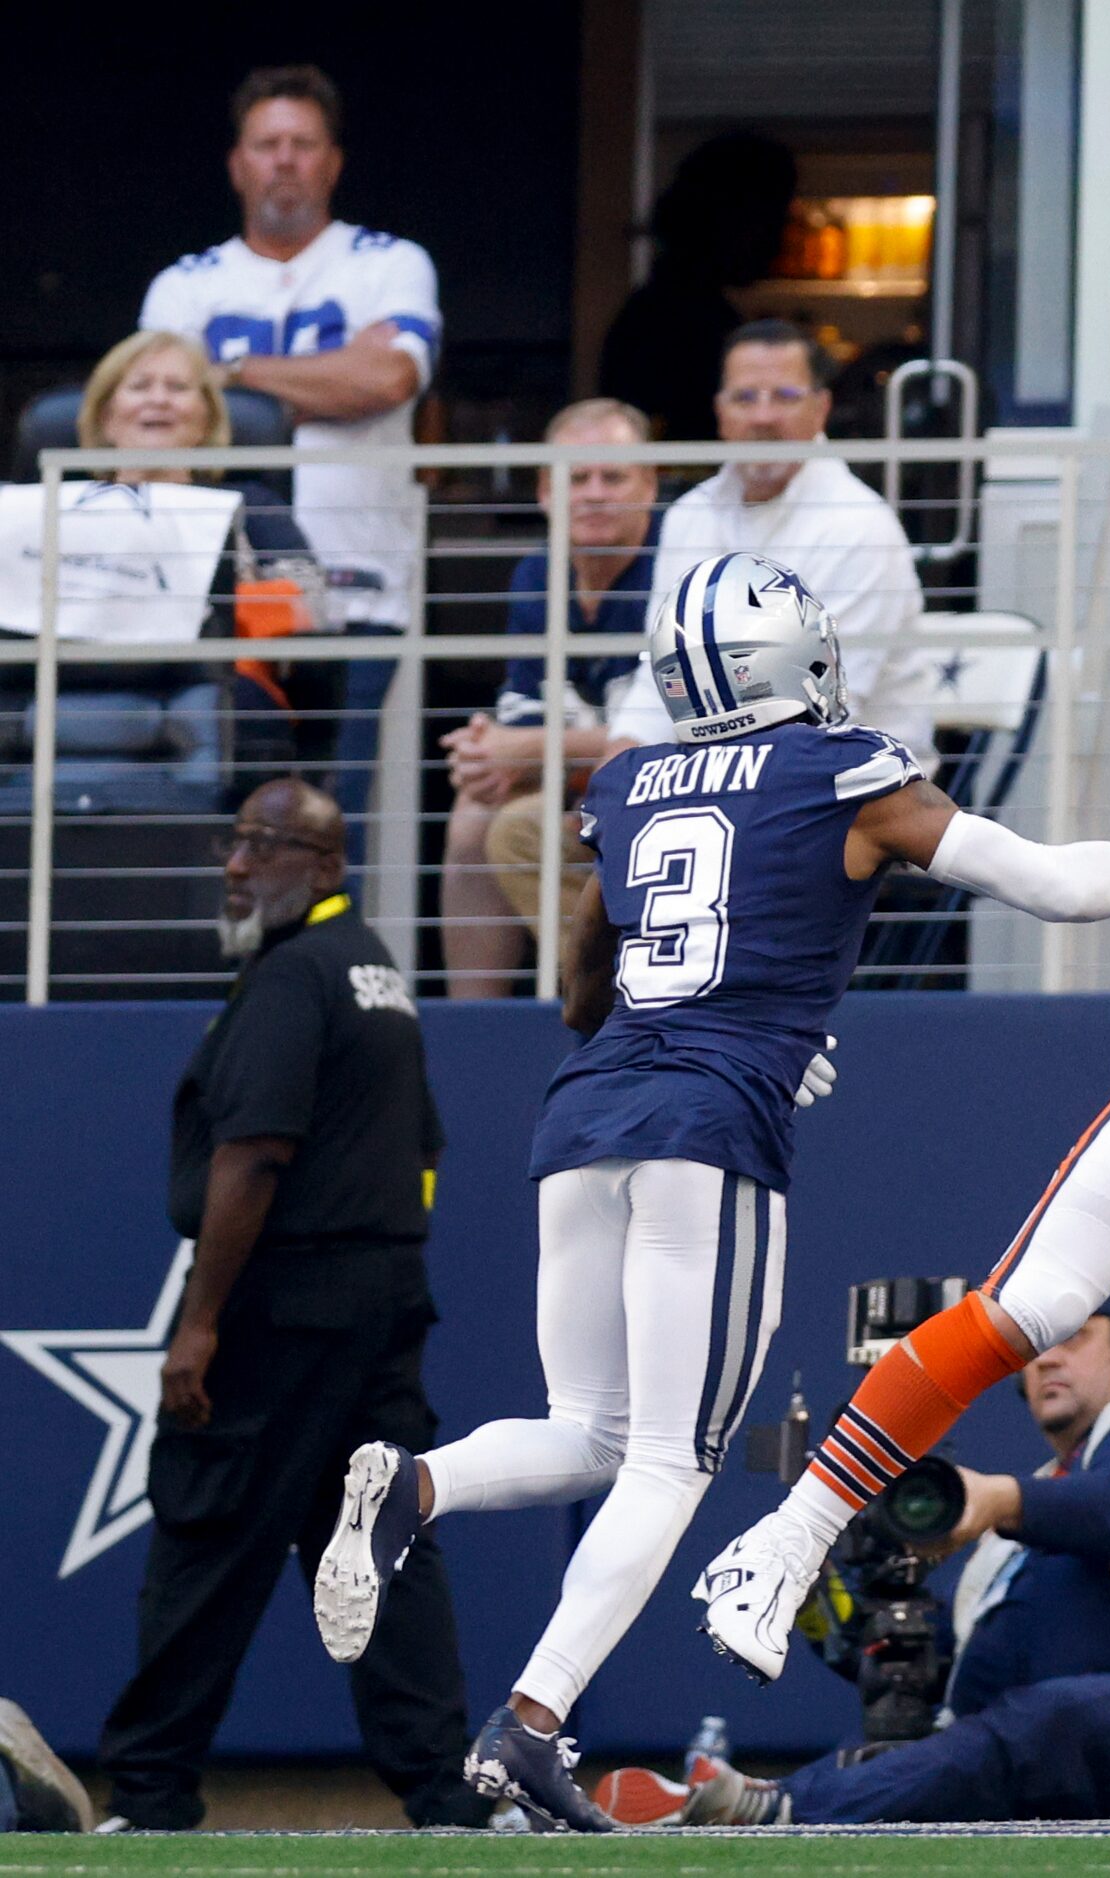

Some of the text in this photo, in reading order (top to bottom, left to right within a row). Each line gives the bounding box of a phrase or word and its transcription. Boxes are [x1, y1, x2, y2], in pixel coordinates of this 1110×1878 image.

[691, 713, 756, 738] COWBOYS
[626, 744, 773, 806] BROWN
[616, 805, 735, 1009] 3
